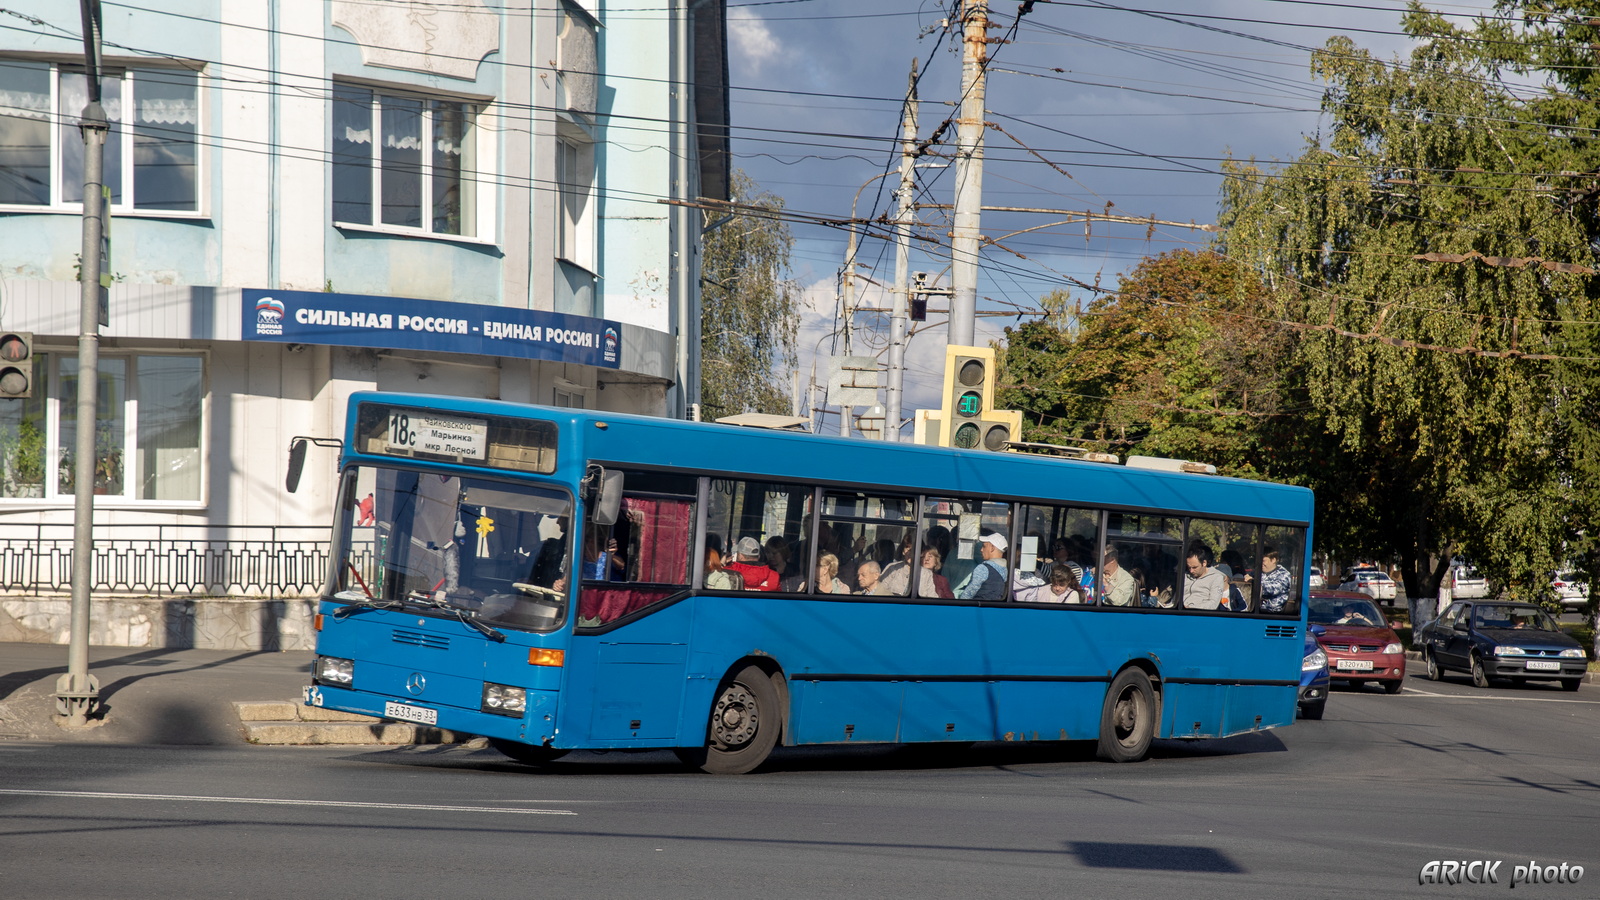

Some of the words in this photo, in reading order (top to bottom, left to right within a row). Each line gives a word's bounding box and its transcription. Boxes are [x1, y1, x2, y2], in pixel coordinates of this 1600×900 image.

[295, 308, 393, 329] СИЛЬНАЯ
[398, 315, 468, 334] РОССИЯ
[483, 320, 542, 341] ЕДИНАЯ
[546, 328, 592, 347] РОССИЯ
[960, 395, 978, 413] 30
[424, 417, 472, 431] Чайковского
[431, 429, 472, 442] Марьинка
[424, 443, 441, 452] мкр
[444, 444, 476, 456] Лесной
